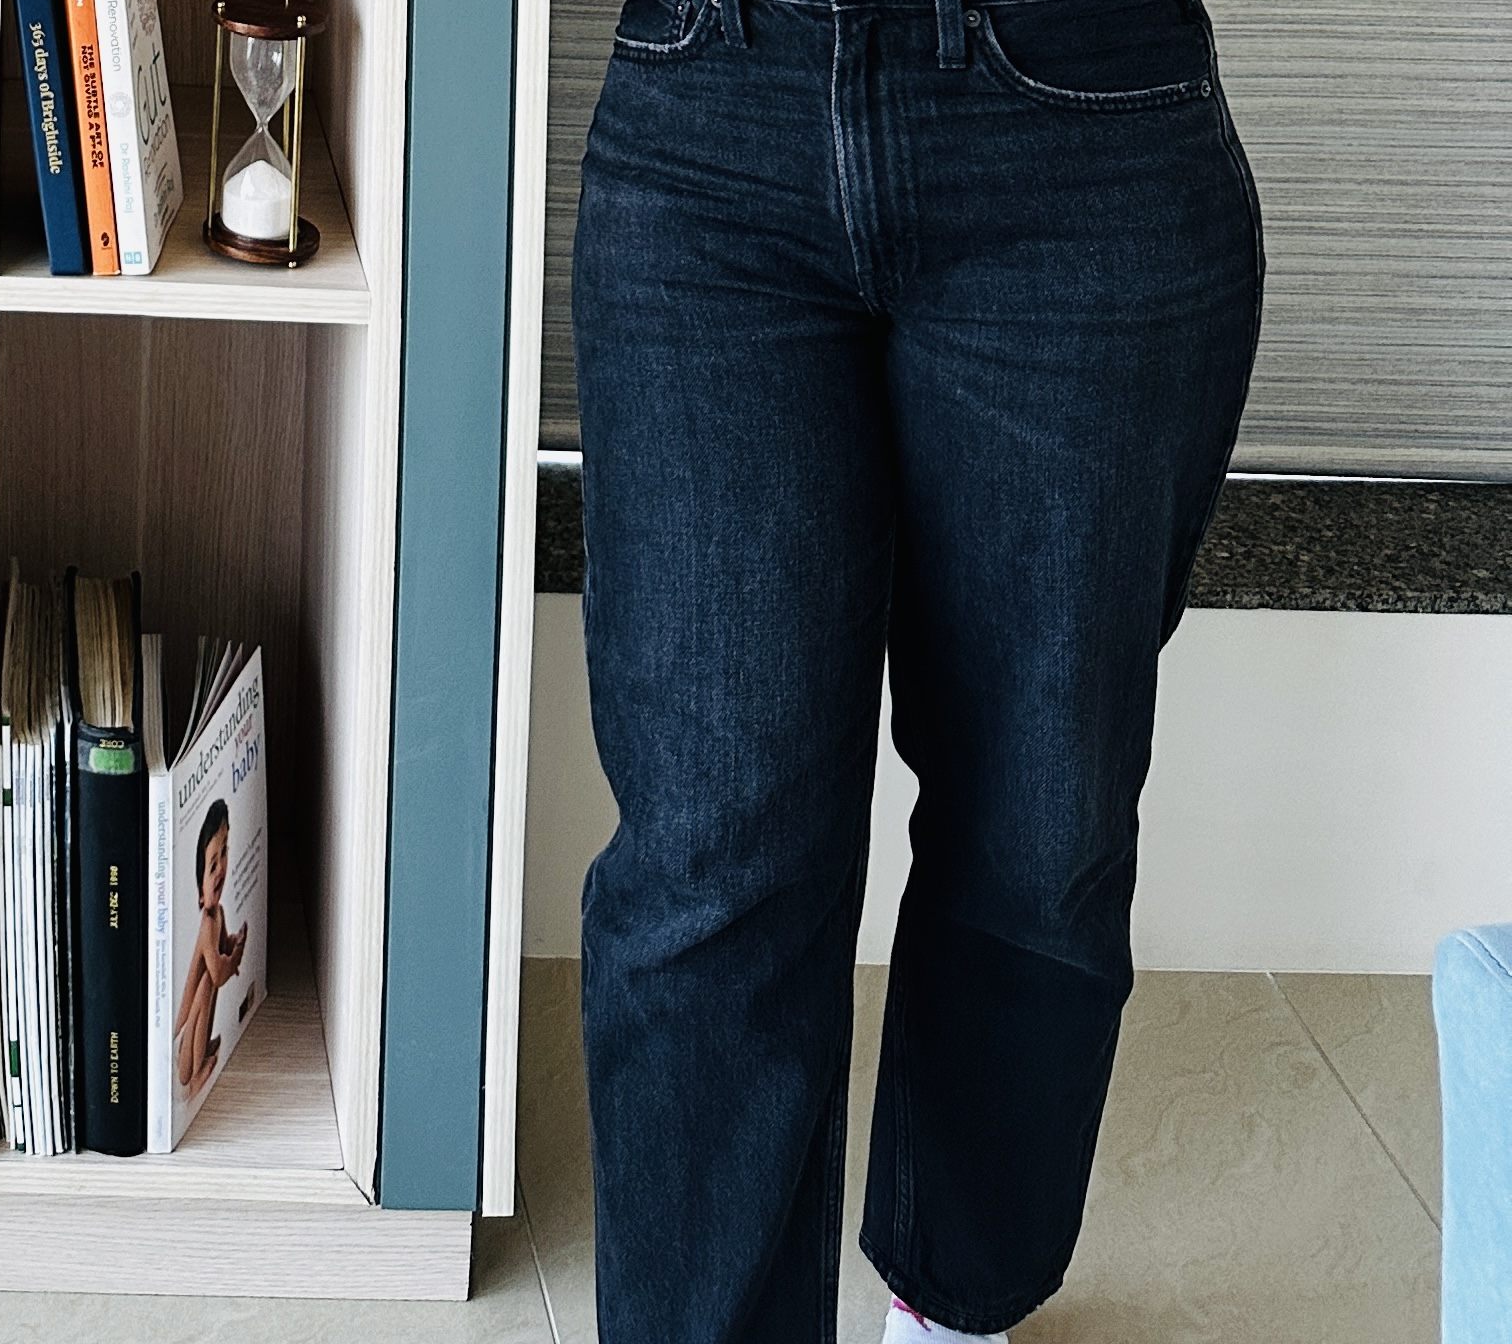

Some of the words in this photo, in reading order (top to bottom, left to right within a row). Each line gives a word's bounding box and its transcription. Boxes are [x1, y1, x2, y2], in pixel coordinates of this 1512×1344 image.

[29, 21, 45, 48] 365
[107, 0, 122, 72] Renovation
[33, 48, 49, 82] days
[81, 45, 89, 70] NOT
[86, 44, 94, 69] THE
[39, 81, 54, 100] of
[84, 73, 94, 119] GIVING
[89, 72, 100, 119] SUBTLE
[41, 99, 63, 175] Brightside
[88, 122, 95, 131] A
[94, 122, 103, 147] ART
[96, 152, 105, 169] OF
[120, 143, 129, 154] Dr
[121, 157, 133, 194] Roshini
[124, 197, 134, 214] Raj
[178, 675, 260, 809] understanding
[234, 713, 253, 757] your
[231, 732, 262, 794] baby
[156, 801, 169, 879] understanding
[155, 880, 166, 906] your
[155, 907, 169, 934] baby
[110, 1031, 119, 1061] EARTH
[110, 1061, 119, 1074] TO
[110, 1076, 119, 1104] DOWN
